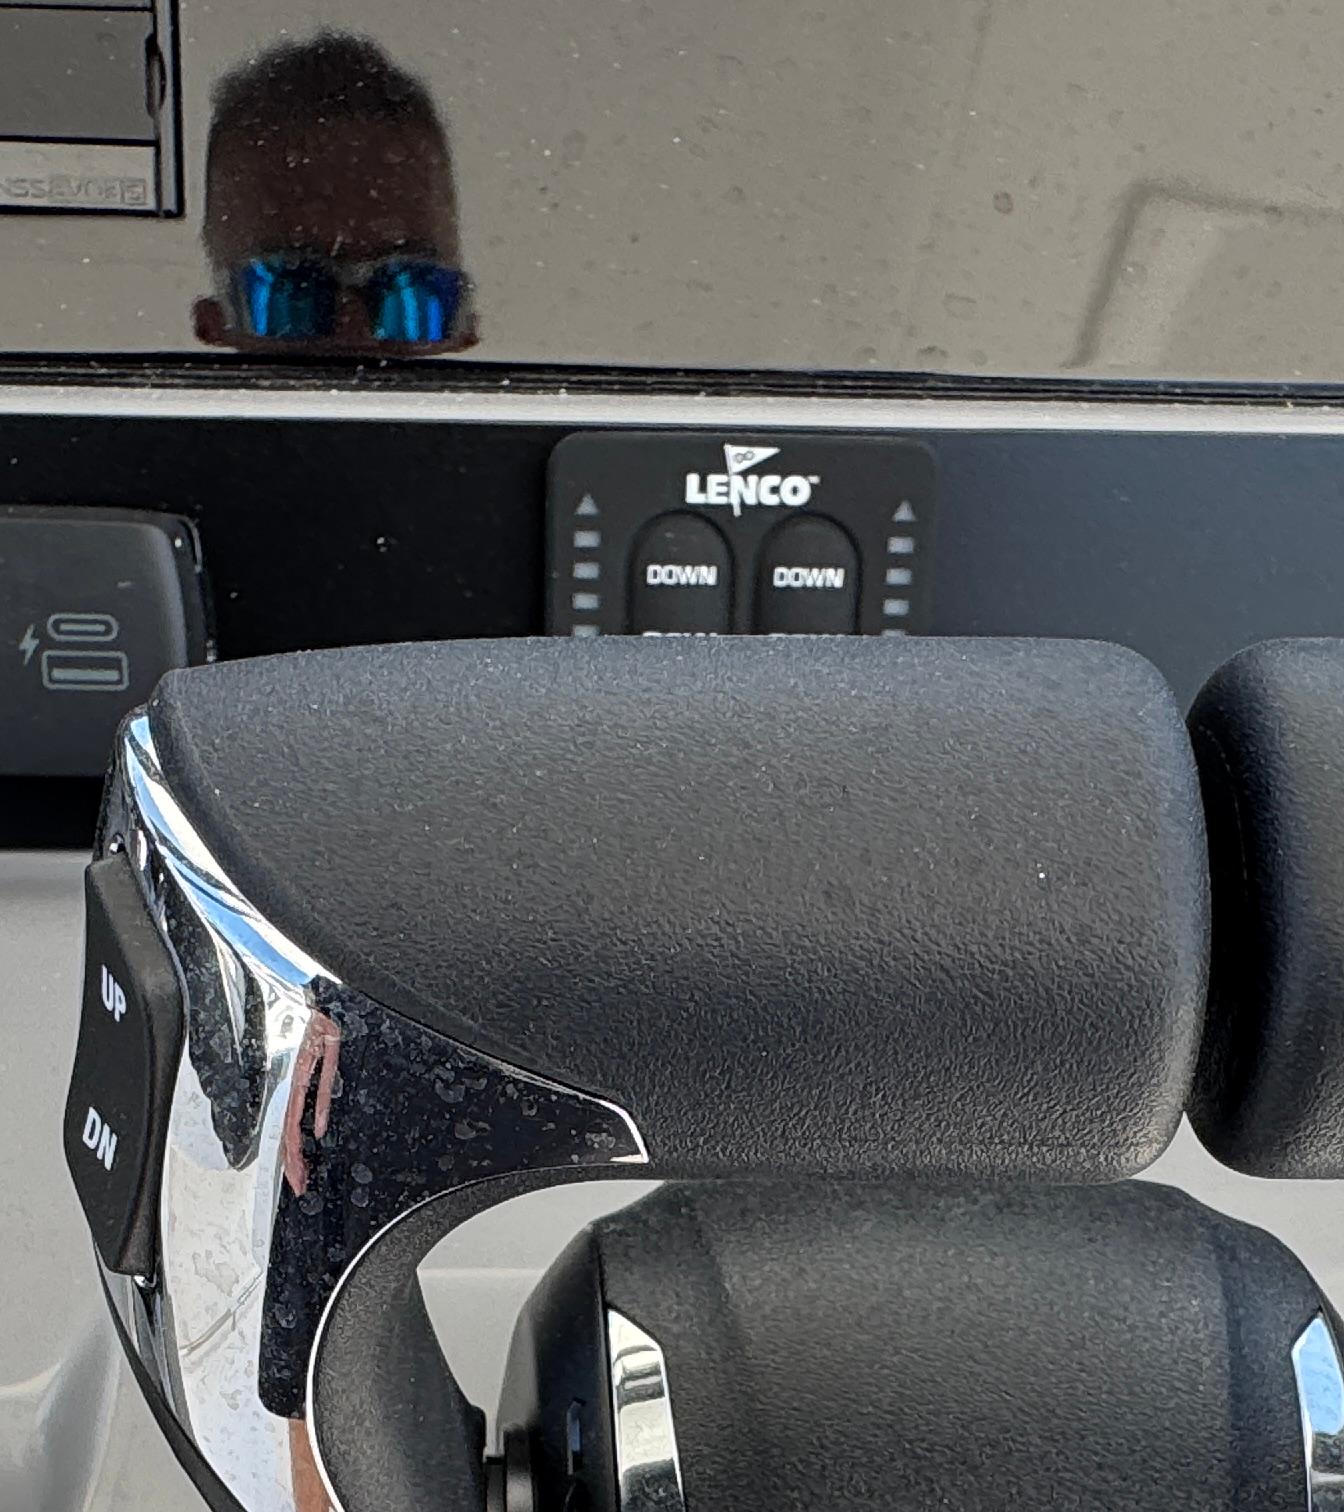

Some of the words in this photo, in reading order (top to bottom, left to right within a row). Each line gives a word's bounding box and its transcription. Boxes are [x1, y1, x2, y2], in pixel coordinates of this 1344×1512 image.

[685, 473, 812, 507] LENCO
[646, 564, 718, 587] DOWN
[773, 567, 845, 590] DOWN
[100, 963, 127, 1023] UP
[82, 1106, 118, 1172] DN
